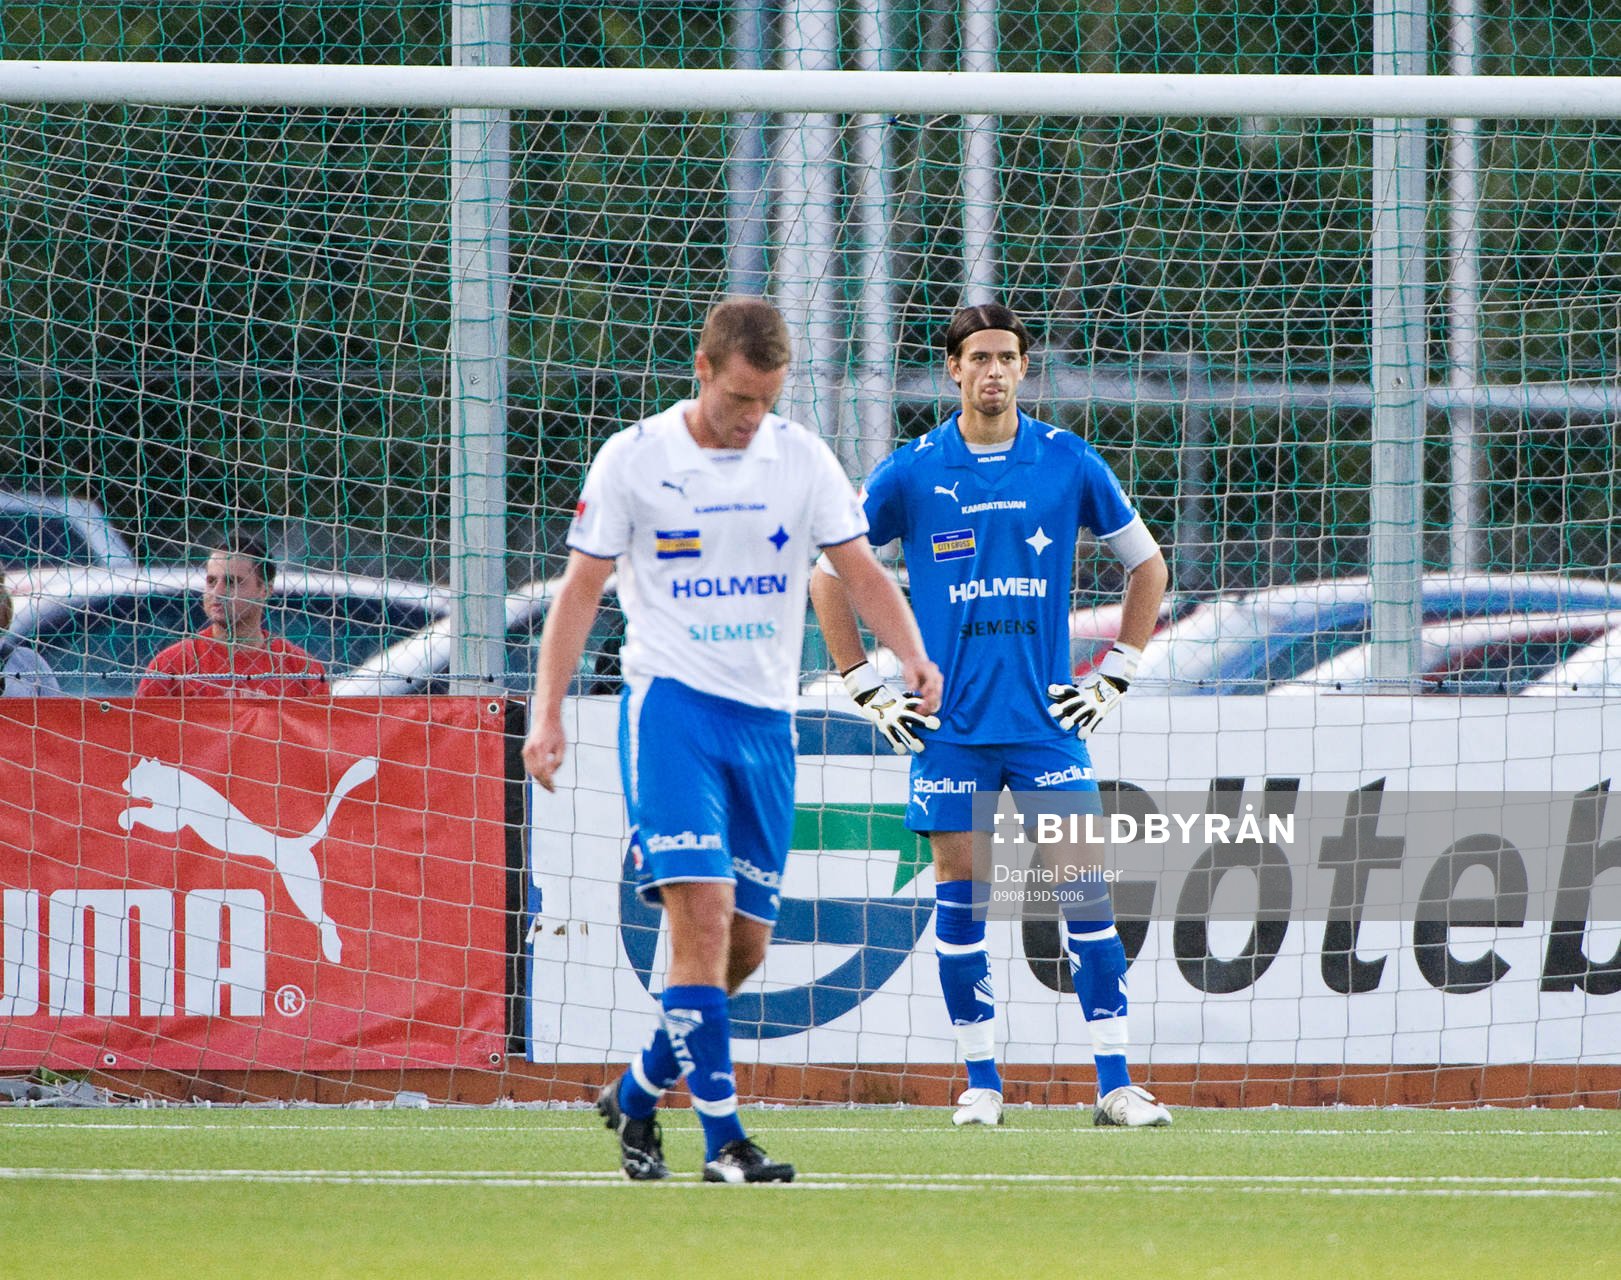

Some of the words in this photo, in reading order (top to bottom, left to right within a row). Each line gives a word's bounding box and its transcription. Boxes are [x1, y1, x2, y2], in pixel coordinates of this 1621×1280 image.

[672, 573, 787, 598] HOLMEN
[949, 577, 1047, 604] HOLMEN
[688, 621, 775, 641] SIEMENS
[960, 619, 1037, 640] SIEMENS
[913, 777, 977, 794] stadium
[646, 831, 723, 854] stadium
